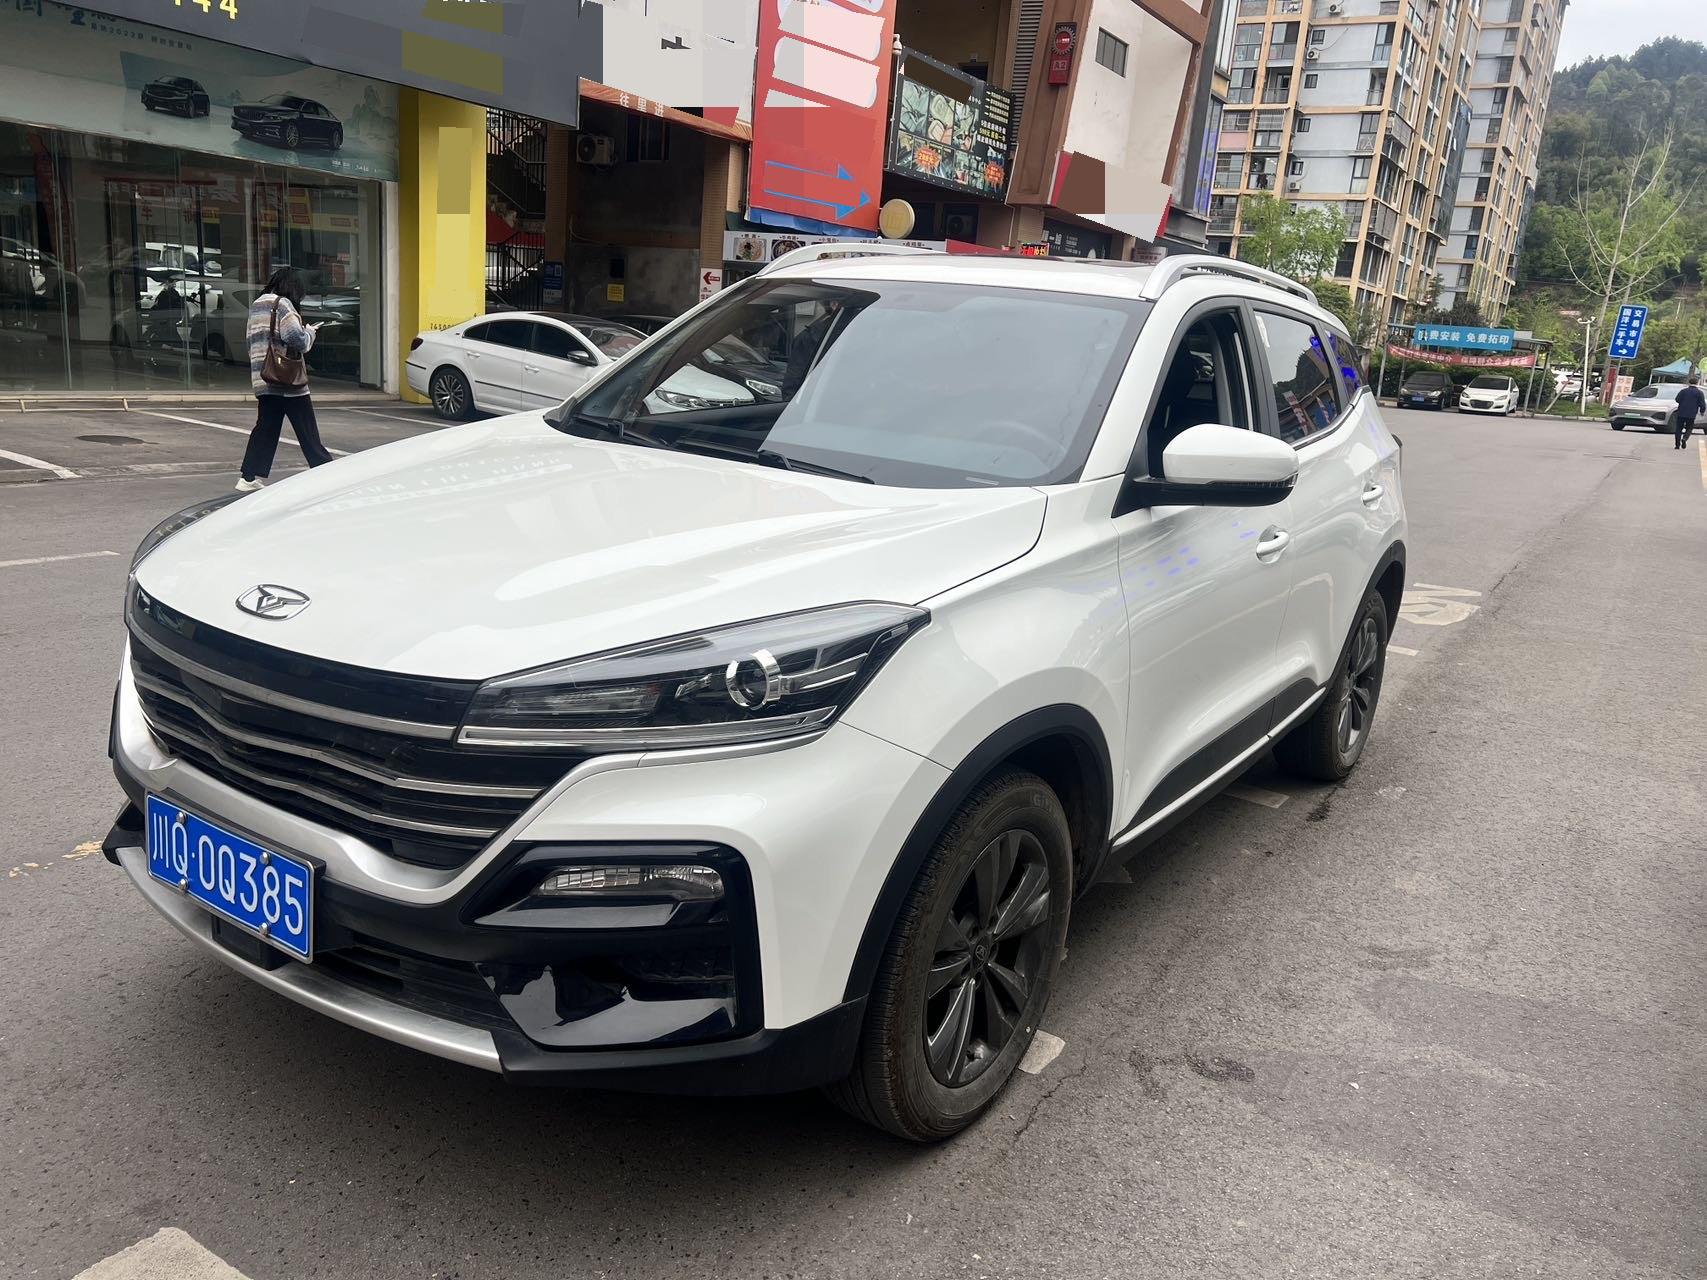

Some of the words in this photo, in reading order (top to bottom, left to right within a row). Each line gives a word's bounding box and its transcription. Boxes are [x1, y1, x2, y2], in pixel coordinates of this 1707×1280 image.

[1465, 332, 1510, 345] 免费拓印
[1625, 309, 1643, 348] 交易市场
